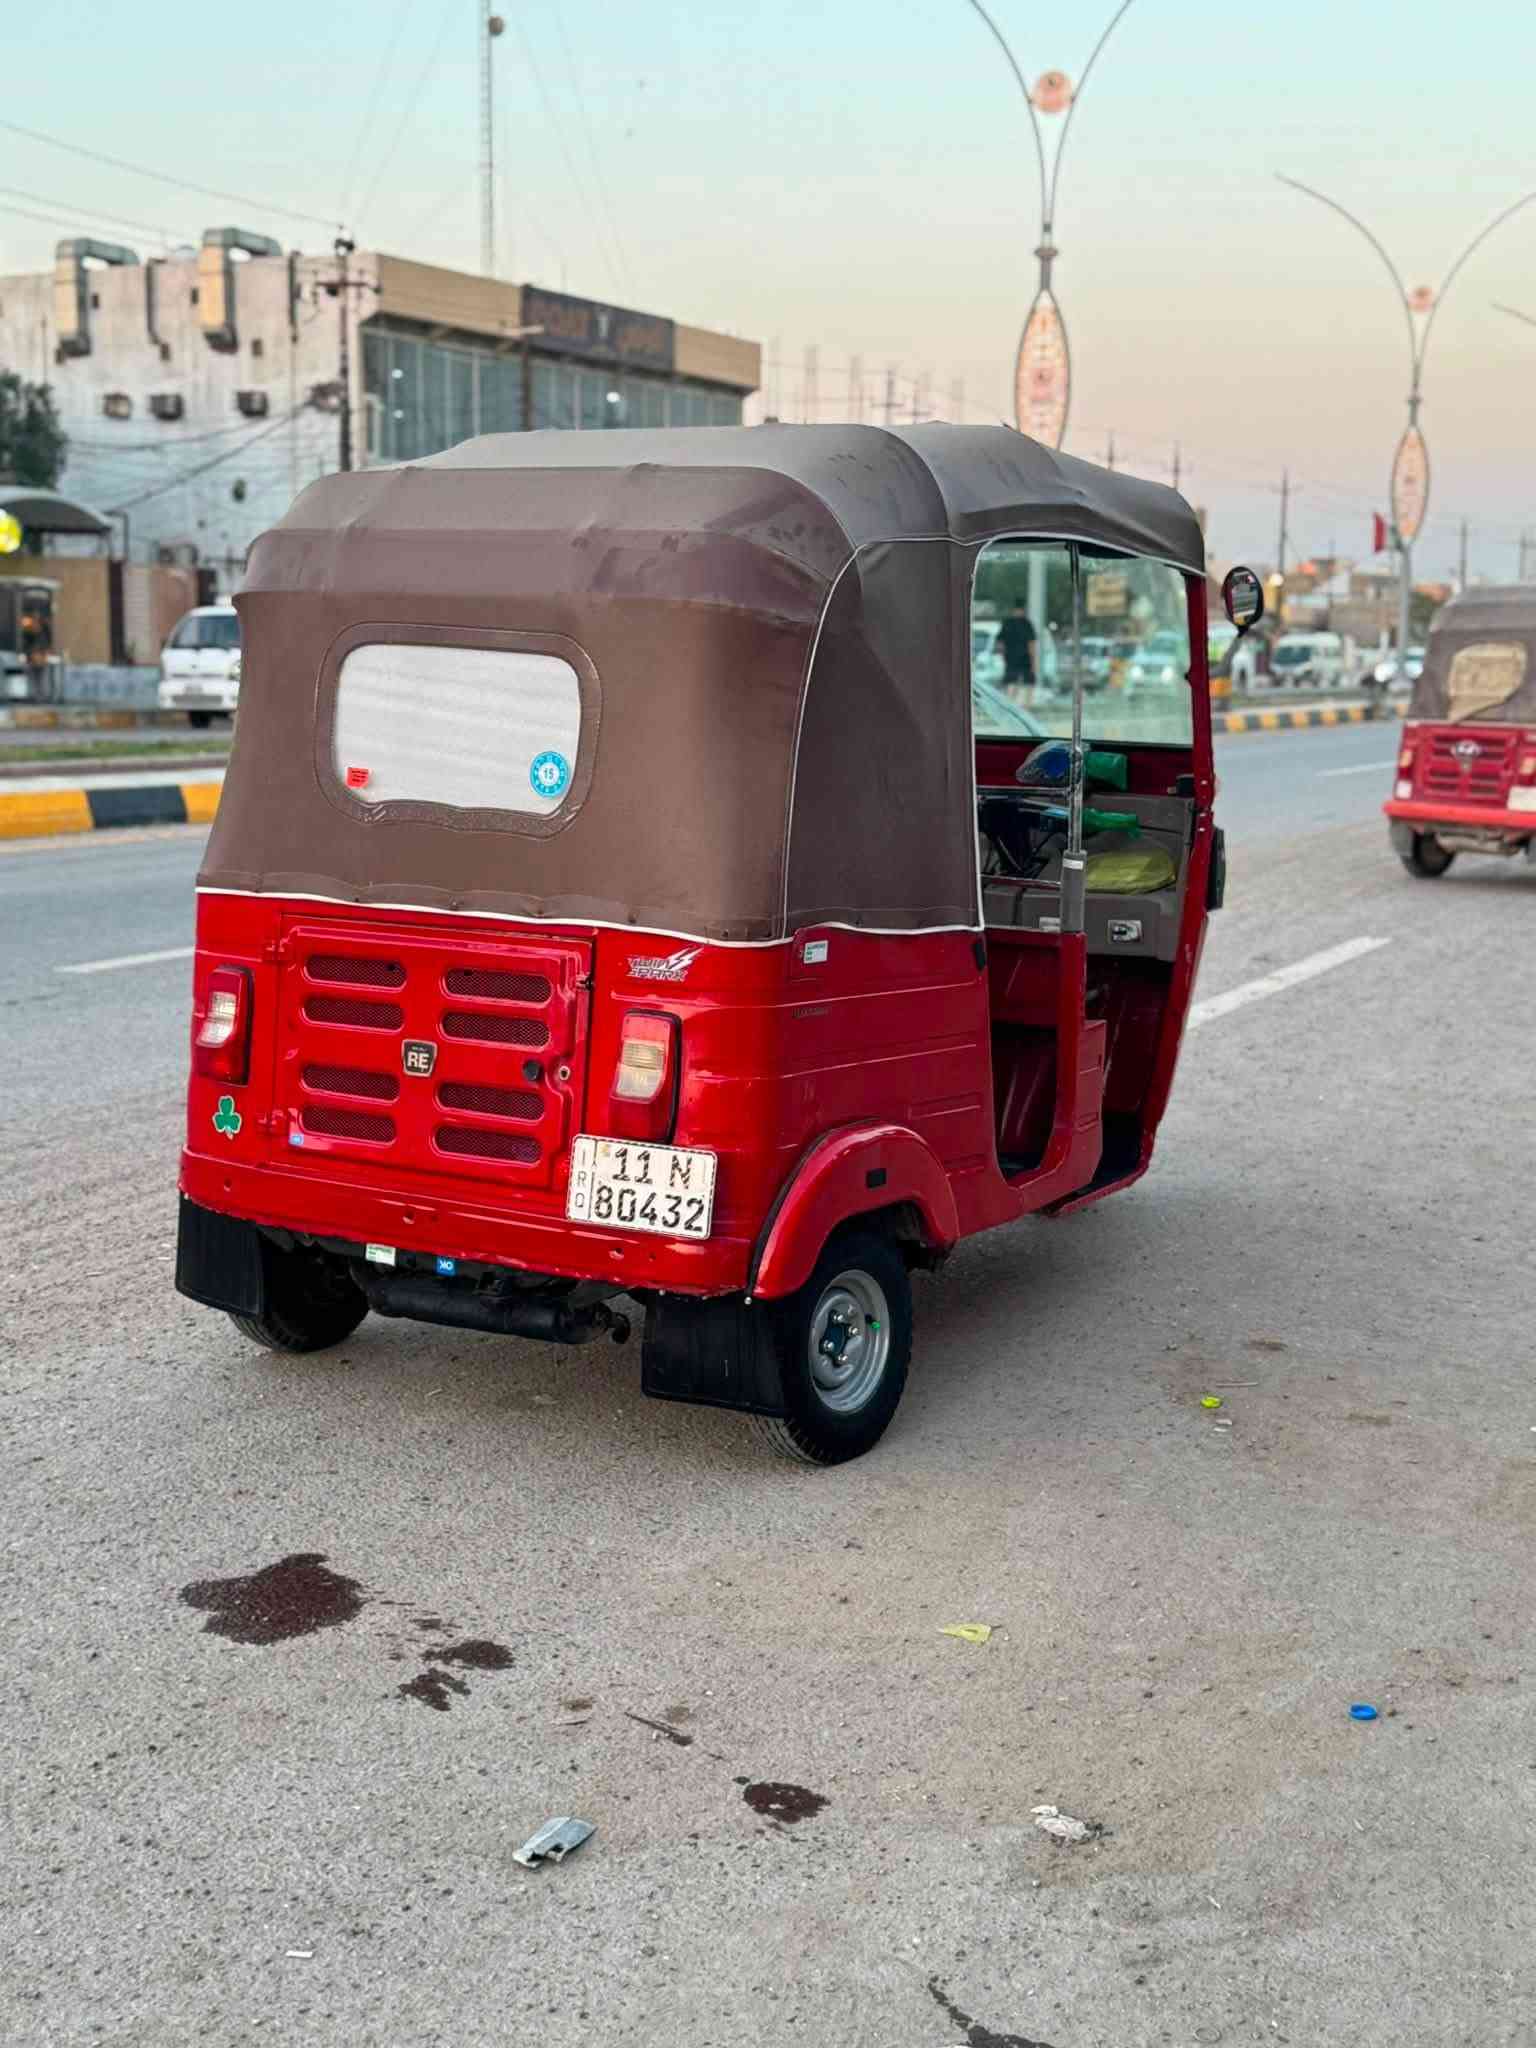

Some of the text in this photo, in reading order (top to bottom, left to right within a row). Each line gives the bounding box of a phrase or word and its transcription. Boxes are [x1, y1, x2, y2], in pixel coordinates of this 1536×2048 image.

[407, 1051, 430, 1069] RE
[612, 1147, 693, 1190] 11 N
[594, 1185, 705, 1233] 80432
